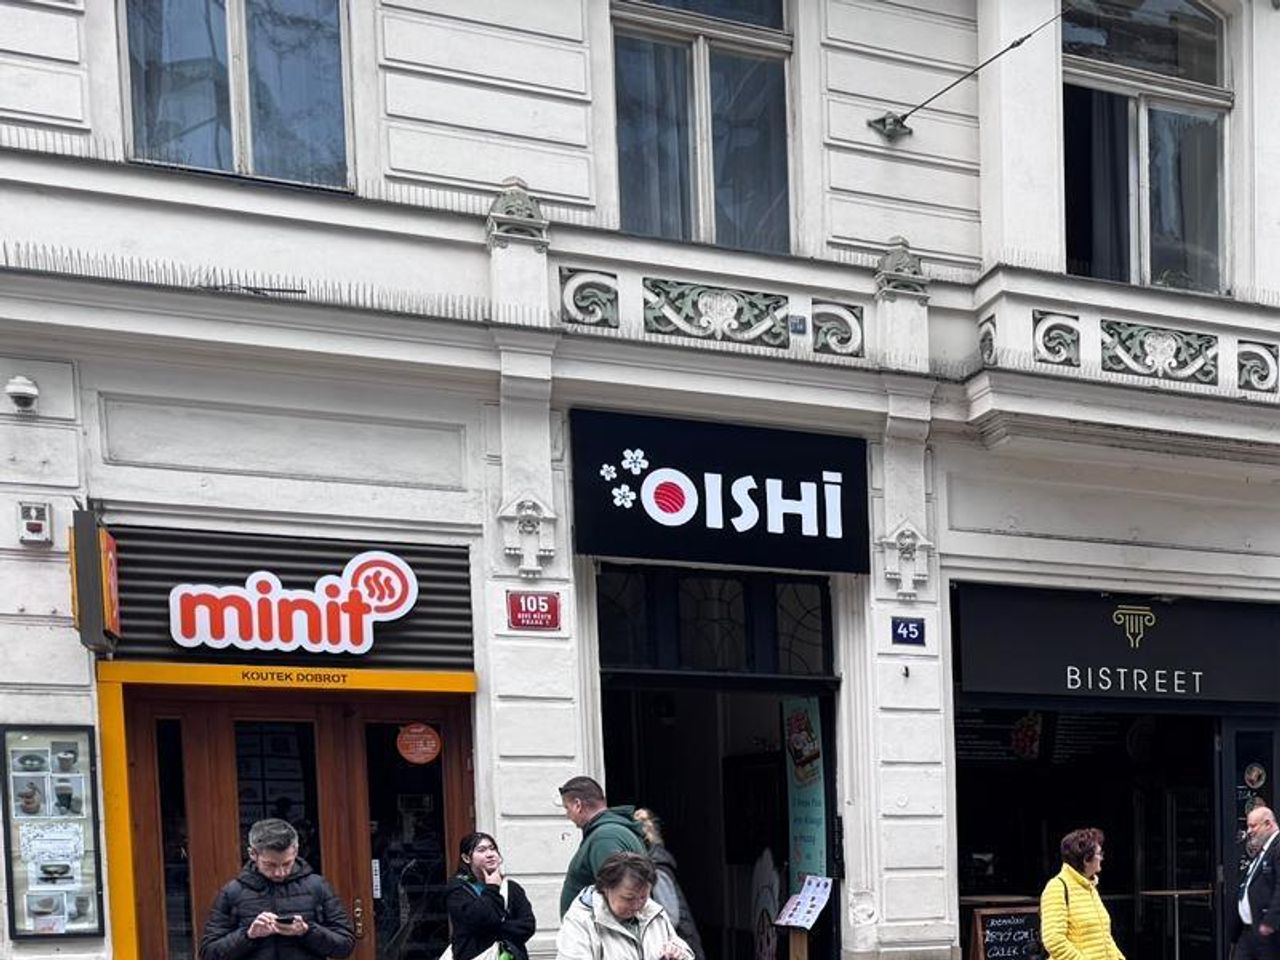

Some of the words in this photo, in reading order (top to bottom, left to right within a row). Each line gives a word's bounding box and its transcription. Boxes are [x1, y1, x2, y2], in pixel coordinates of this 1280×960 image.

[520, 595, 549, 613] 105
[180, 580, 372, 647] minit
[897, 622, 919, 638] 45
[241, 671, 293, 682] KOUTEK
[296, 672, 348, 684] DOBROT
[1067, 665, 1203, 693] BISTREET
